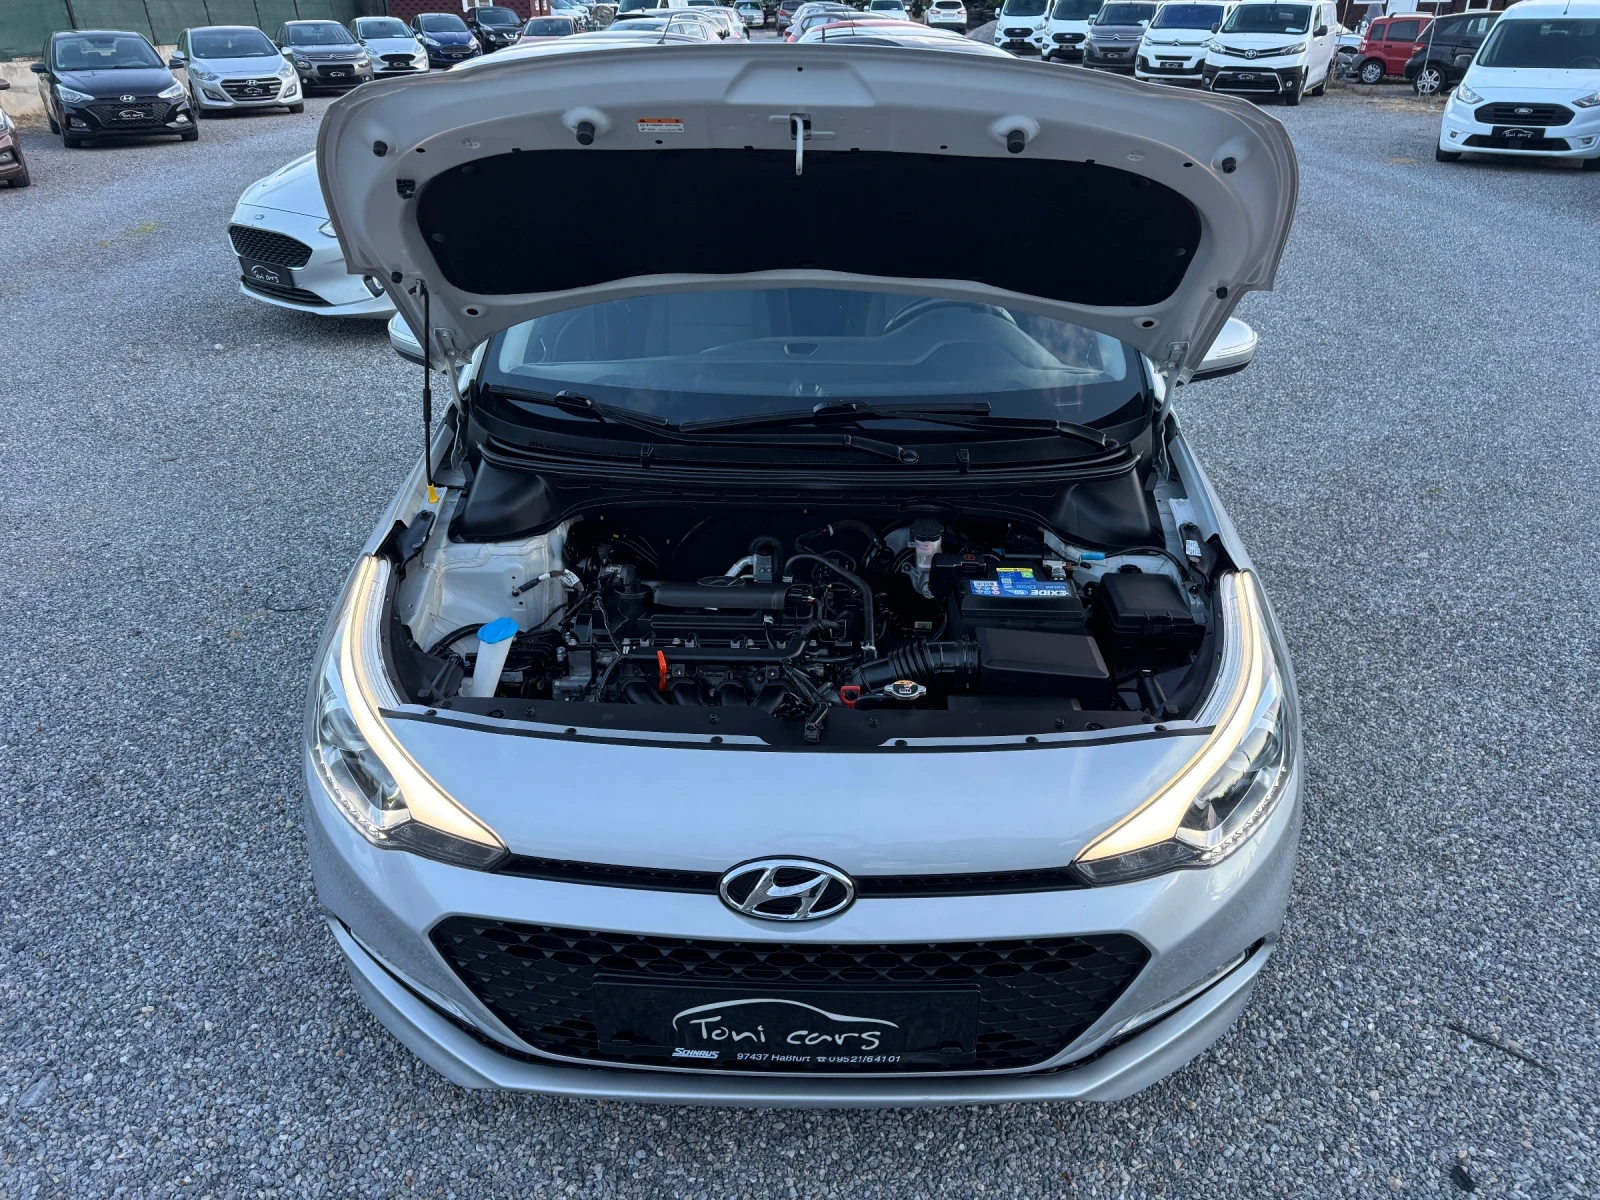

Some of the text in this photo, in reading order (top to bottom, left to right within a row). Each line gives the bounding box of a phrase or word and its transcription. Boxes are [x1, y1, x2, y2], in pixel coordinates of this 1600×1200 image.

[689, 1015, 881, 1050] Toni cars
[736, 1052, 770, 1061] 97437
[771, 1054, 811, 1062] Haßfurt
